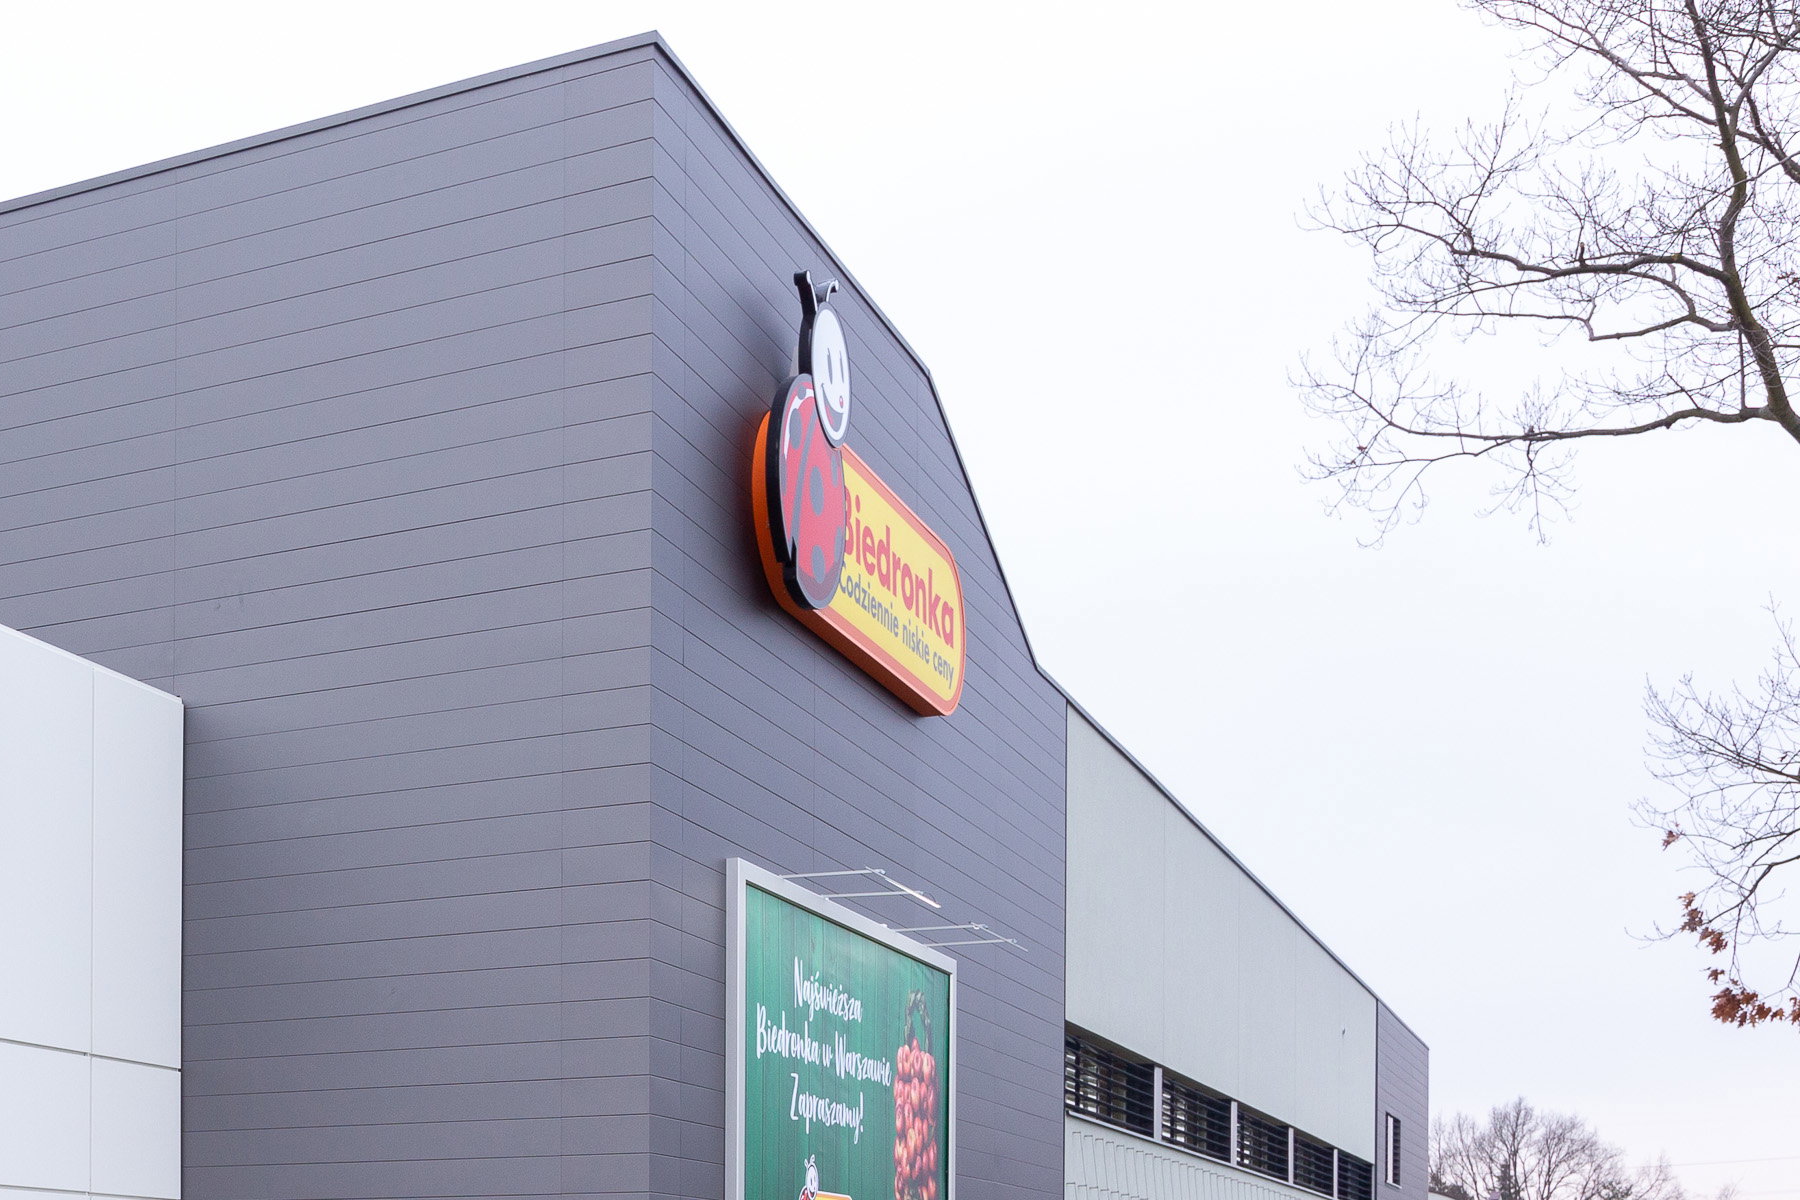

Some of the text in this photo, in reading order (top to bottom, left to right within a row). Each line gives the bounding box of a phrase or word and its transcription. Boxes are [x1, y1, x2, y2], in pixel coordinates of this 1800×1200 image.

[902, 619, 930, 665] niskie
[933, 651, 955, 690] ceny
[794, 956, 863, 1023] Najświeższa
[756, 1003, 893, 1087] Biedronka w Warszawie
[790, 1072, 864, 1145] Zapraszamy!
